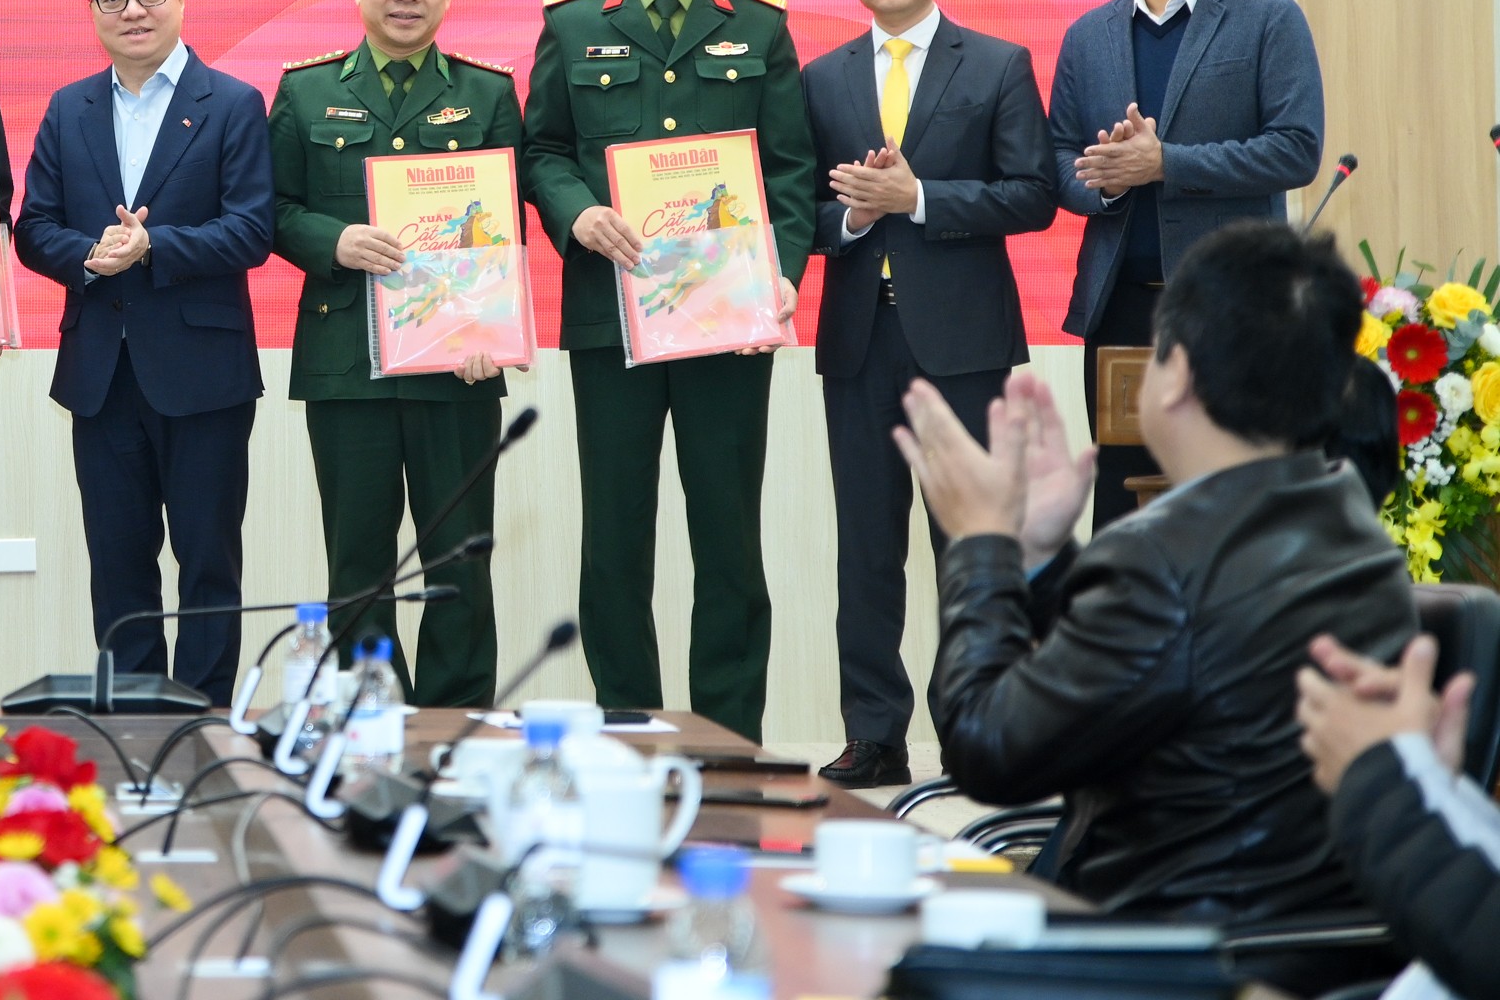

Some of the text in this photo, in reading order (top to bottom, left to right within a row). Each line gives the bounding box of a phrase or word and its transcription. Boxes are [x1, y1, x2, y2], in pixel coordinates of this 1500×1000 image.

[649, 148, 719, 169] Nhân Dân
[406, 165, 475, 183] Nhân Dân
[664, 198, 698, 208] XUÂN
[418, 214, 453, 223] XUÂN
[642, 209, 685, 238] Cất
[397, 223, 438, 250] Cất
